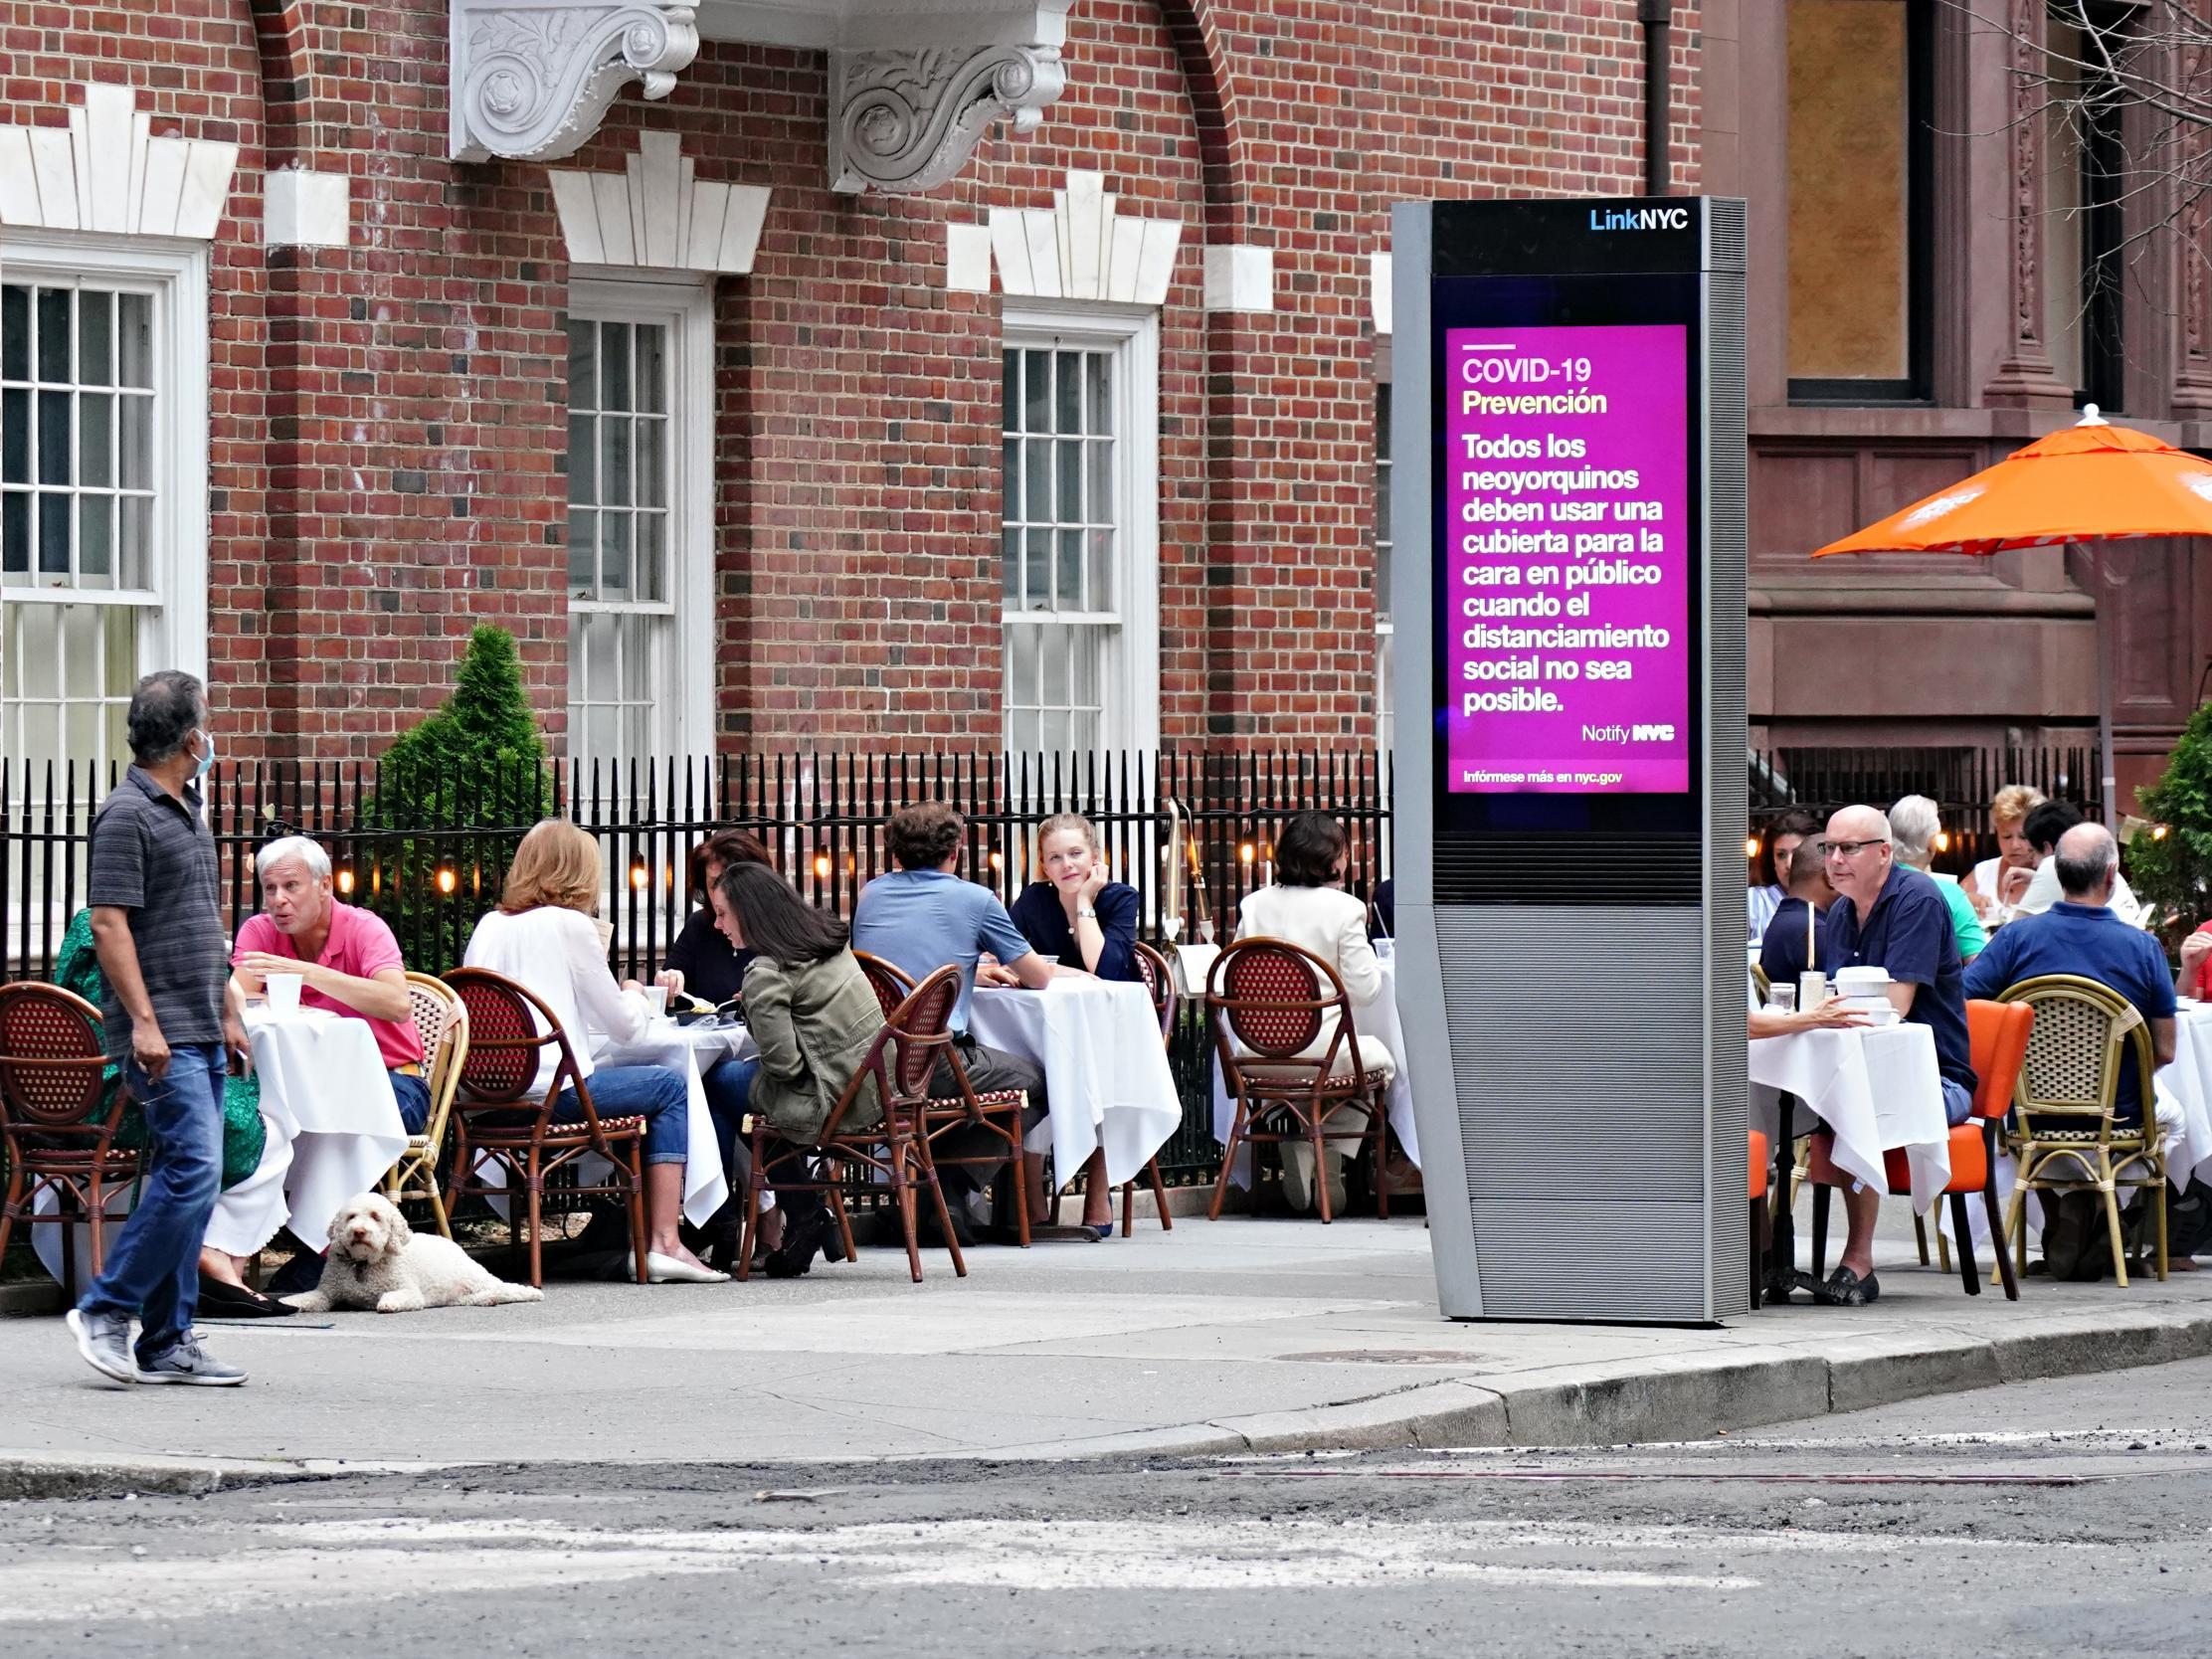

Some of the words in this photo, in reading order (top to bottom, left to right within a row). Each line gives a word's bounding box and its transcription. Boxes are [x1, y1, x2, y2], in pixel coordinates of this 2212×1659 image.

[1590, 209, 1688, 230] LinkNYC
[1463, 358, 1591, 383] COVID-19
[1463, 387, 1607, 415] Prevención
[1462, 434, 1541, 459] Todos
[1548, 434, 1586, 458] los
[1463, 464, 1639, 495] neoyorquinos
[1462, 497, 1544, 522] deben
[1551, 502, 1608, 521] usar
[1614, 501, 1663, 521] una
[1463, 528, 1568, 553] cubierta
[1574, 533, 1634, 558] para
[1640, 527, 1663, 553] la
[1463, 566, 1520, 585] cara
[1526, 566, 1560, 585] en
[1566, 558, 1661, 590] público
[1463, 592, 1561, 617] cuando
[1566, 592, 1589, 617] el
[1463, 623, 1670, 648] distanciamiento
[1464, 655, 1539, 680] social
[1545, 660, 1579, 679] no
[1585, 660, 1632, 680] sea
[1464, 686, 1564, 717] posible.
[1581, 724, 1630, 745] Notify
[1632, 724, 1675, 741] NYC
[1464, 770, 1525, 783] Infórmese
[1528, 770, 1554, 783] más
[1557, 773, 1571, 783] en
[1574, 773, 1622, 785] nyc.gov
